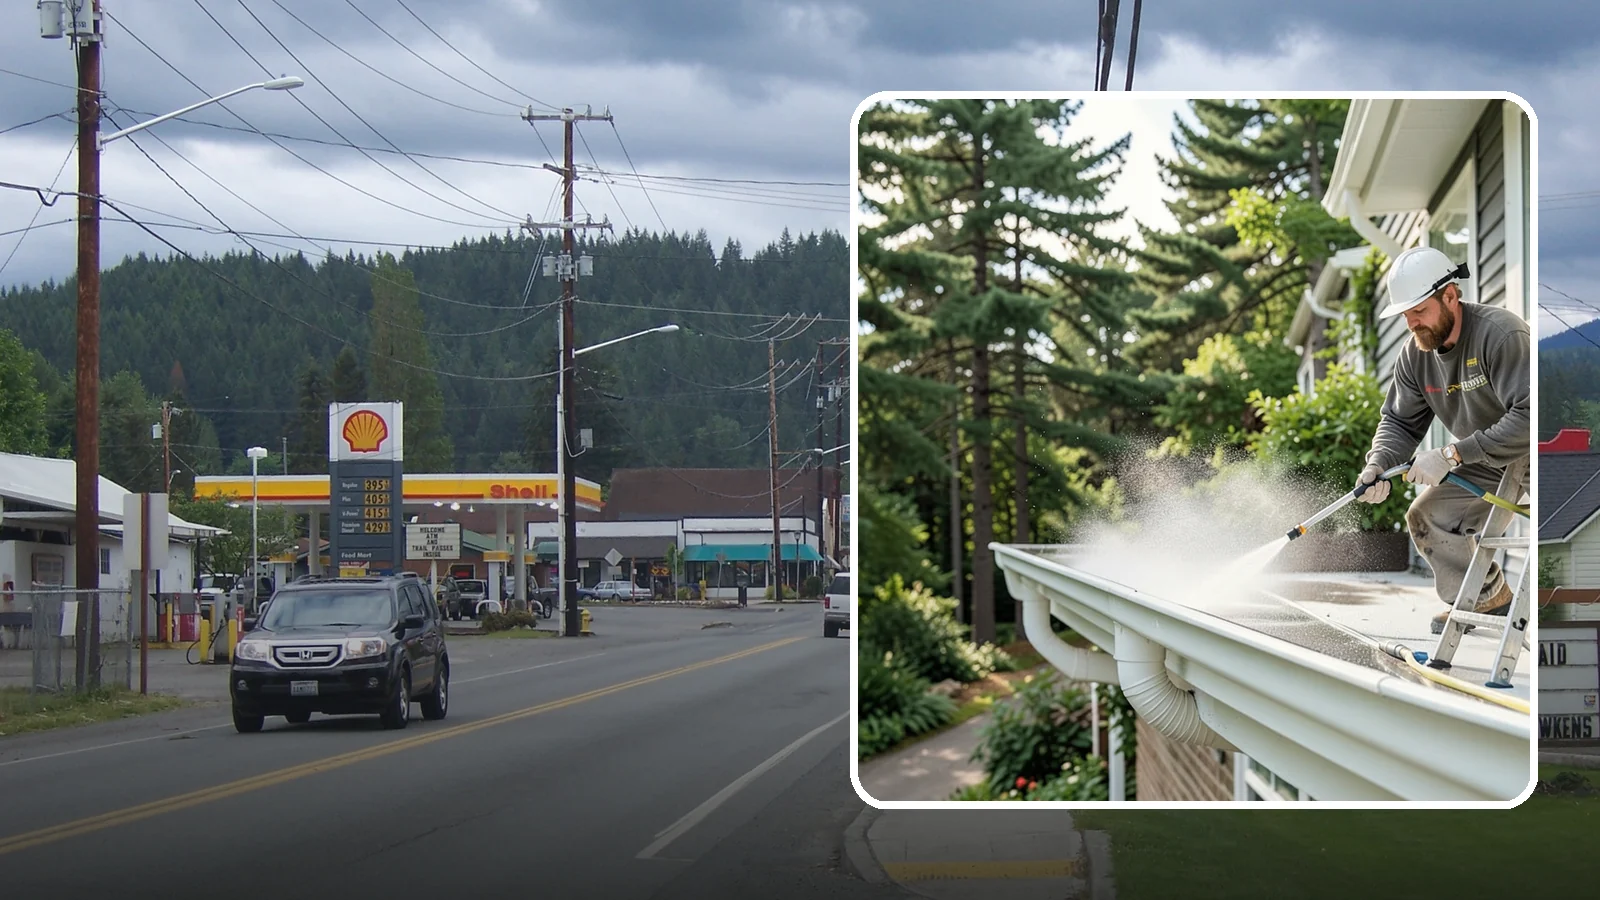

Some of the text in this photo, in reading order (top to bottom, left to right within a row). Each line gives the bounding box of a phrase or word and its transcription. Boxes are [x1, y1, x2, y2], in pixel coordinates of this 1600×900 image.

[366, 480, 383, 490] 395
[490, 484, 547, 499] Shell
[366, 494, 383, 504] 405
[366, 508, 383, 518] 415
[366, 522, 383, 533] 429
[1538, 642, 1566, 665] AID
